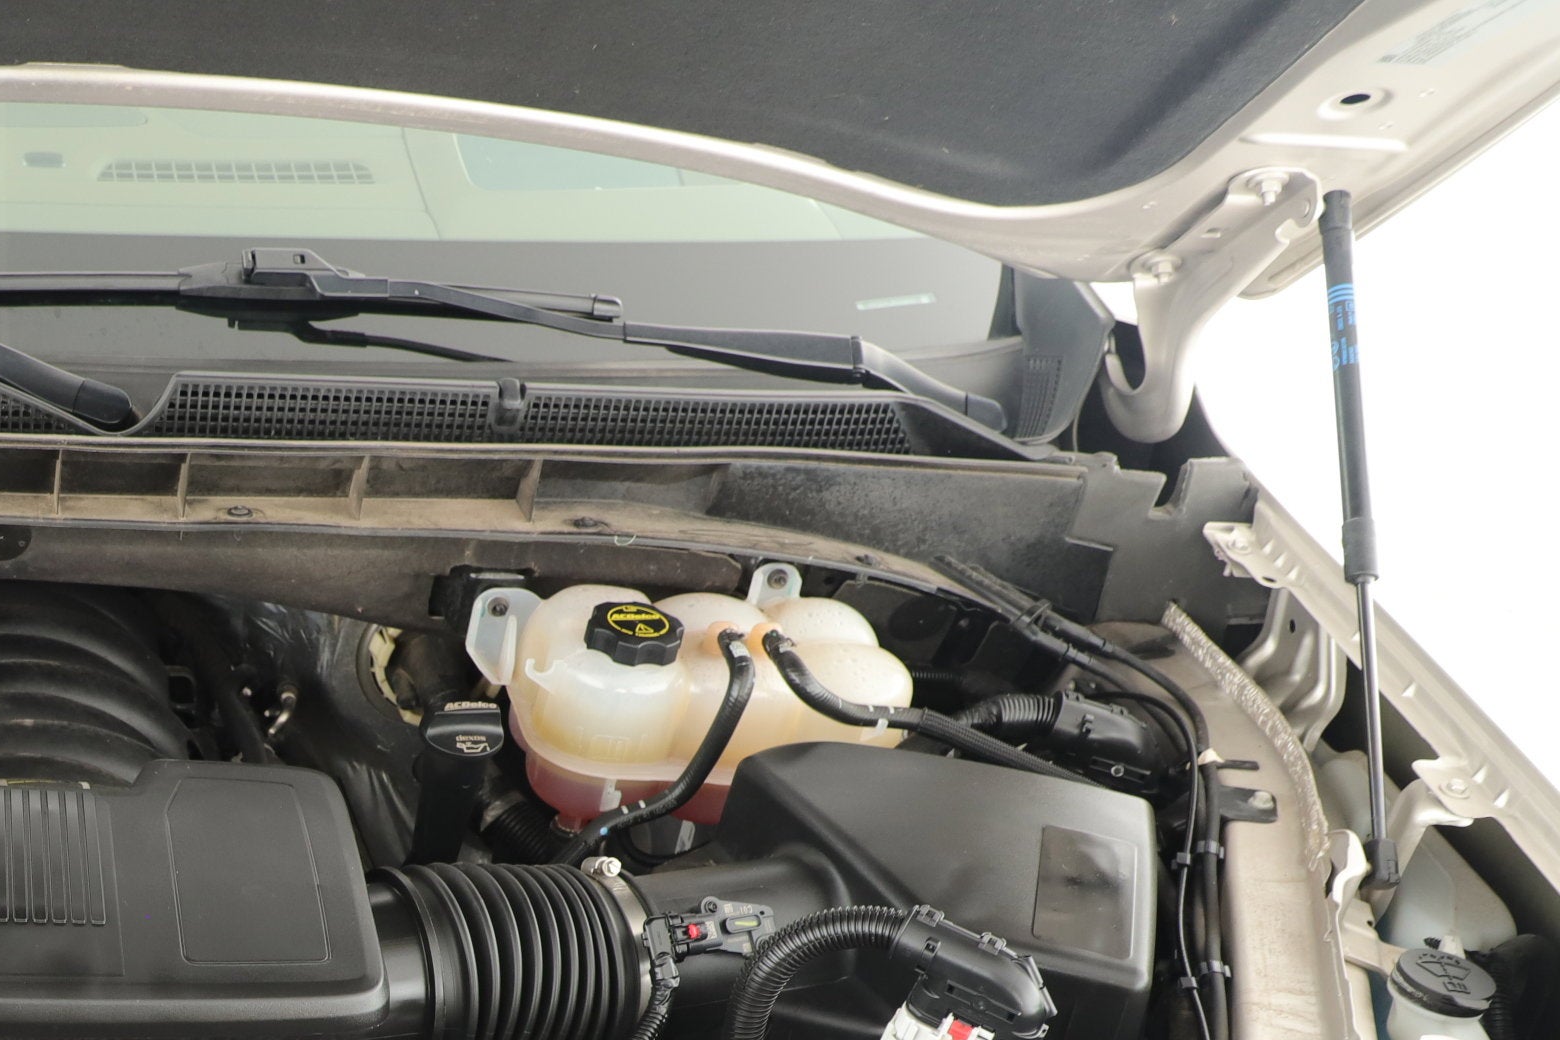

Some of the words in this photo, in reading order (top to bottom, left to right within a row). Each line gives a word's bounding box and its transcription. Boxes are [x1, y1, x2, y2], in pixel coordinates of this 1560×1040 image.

[611, 613, 660, 621] ACDelco
[443, 701, 498, 712] ACDelco
[455, 734, 487, 742] dexos
